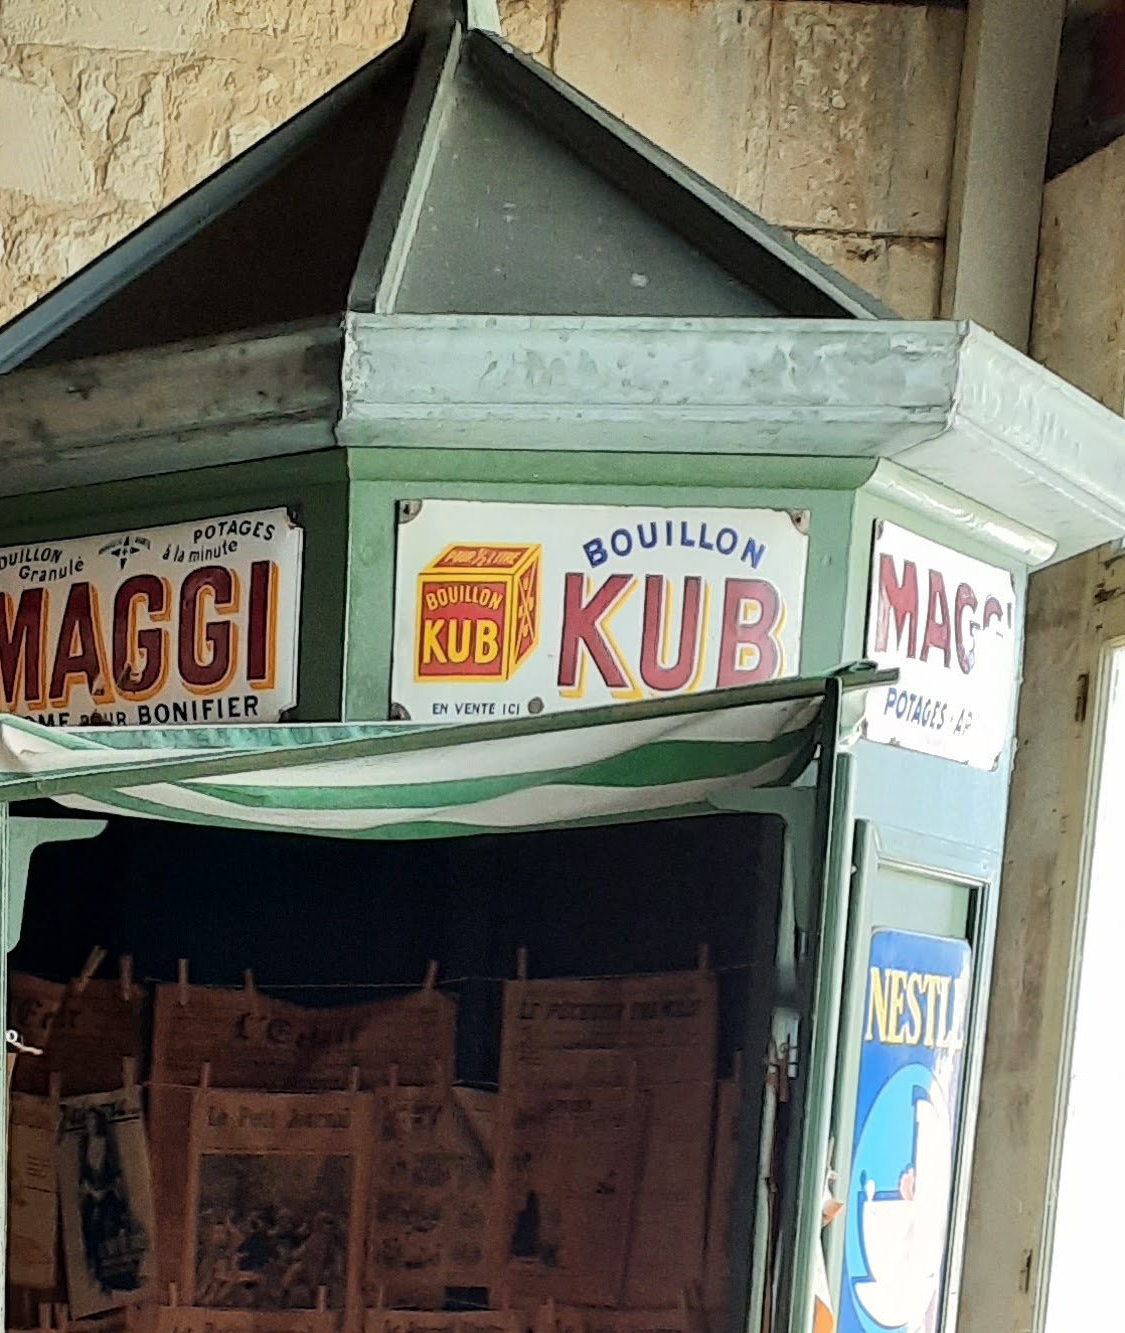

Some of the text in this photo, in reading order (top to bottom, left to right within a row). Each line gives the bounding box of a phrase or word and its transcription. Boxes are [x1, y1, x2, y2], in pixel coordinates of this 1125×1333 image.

[193, 519, 275, 543] POTAGES
[582, 521, 767, 569] BOUILLON
[174, 544, 185, 563] la
[188, 539, 238, 563] minute
[425, 585, 504, 611] BOUILLON
[875, 552, 1012, 675] MAG
[423, 618, 500, 665] KUB
[557, 572, 783, 696] KUB
[137, 696, 259, 726] BONIFIER
[432, 702, 520, 715] EN VENTE ICI
[884, 687, 948, 731] POTAGES
